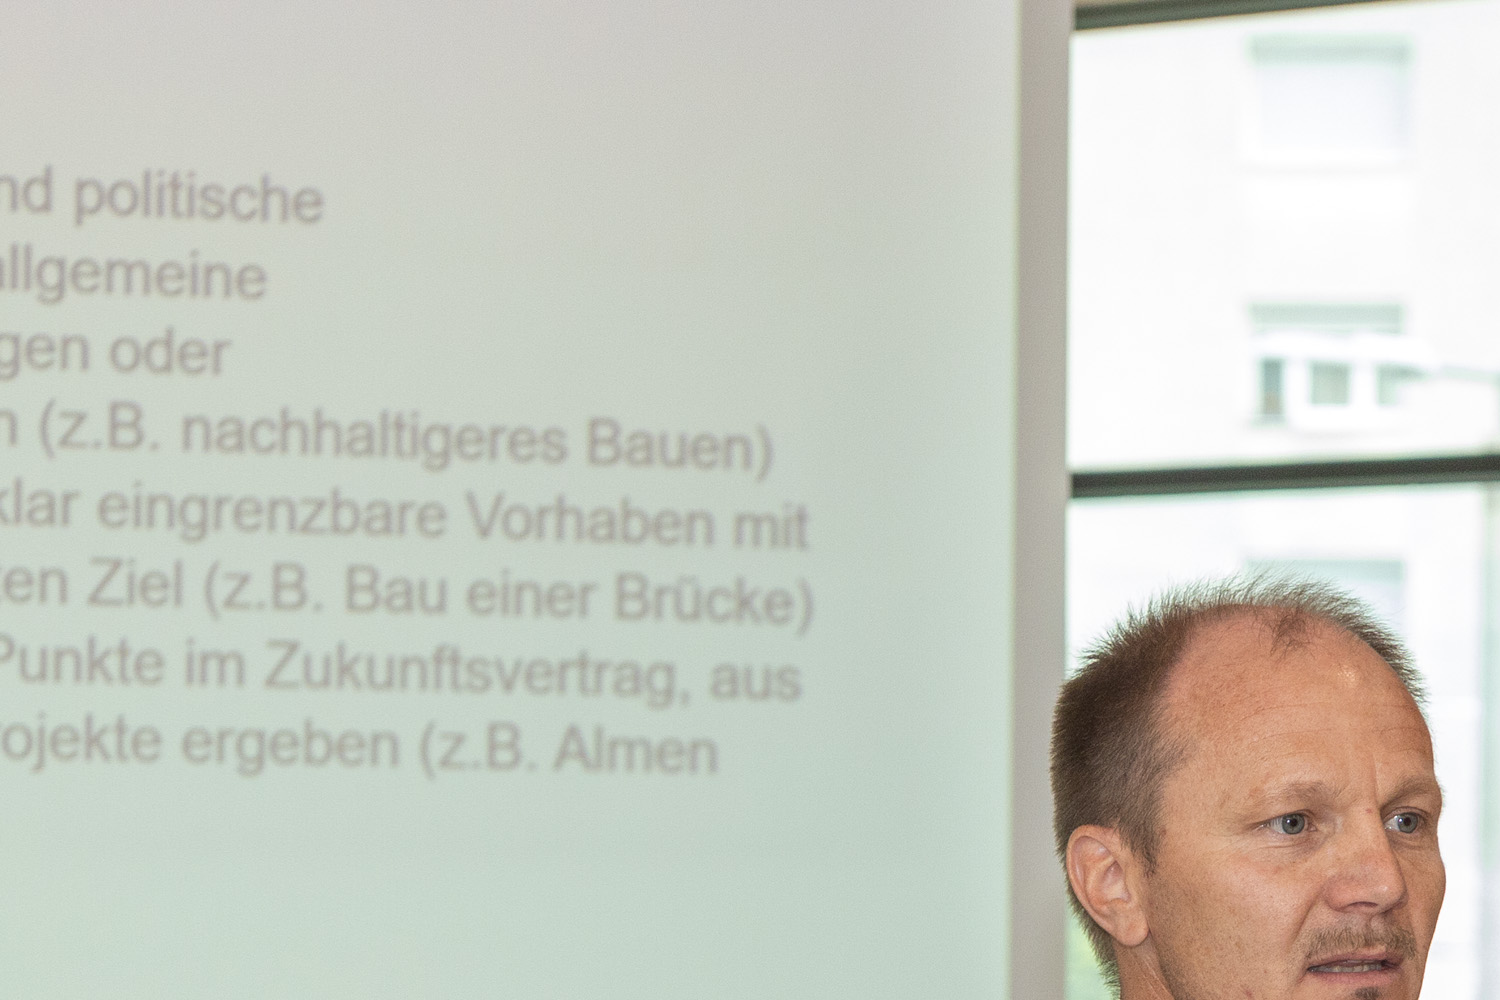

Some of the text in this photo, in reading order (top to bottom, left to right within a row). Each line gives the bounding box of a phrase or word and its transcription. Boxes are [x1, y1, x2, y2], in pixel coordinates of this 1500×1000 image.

[74, 168, 325, 226] politische
[0, 243, 267, 305] llgemeine
[109, 327, 232, 376] oder
[39, 400, 160, 460] (z.B.
[182, 408, 569, 474] nachhaltigeres
[586, 416, 774, 483] Bauen)
[97, 480, 448, 544] eingrenzbare
[465, 491, 715, 548] Vorhaben
[732, 501, 810, 551] mit
[0, 555, 815, 637] en Ziel (z.B. Bau einer Brücke)
[185, 637, 246, 687] im
[264, 639, 692, 711] Zukunftsvertrag,
[709, 662, 803, 703] aus
[181, 717, 401, 778] ergeben
[418, 720, 537, 781] (z.B.
[552, 722, 719, 775] Almen
